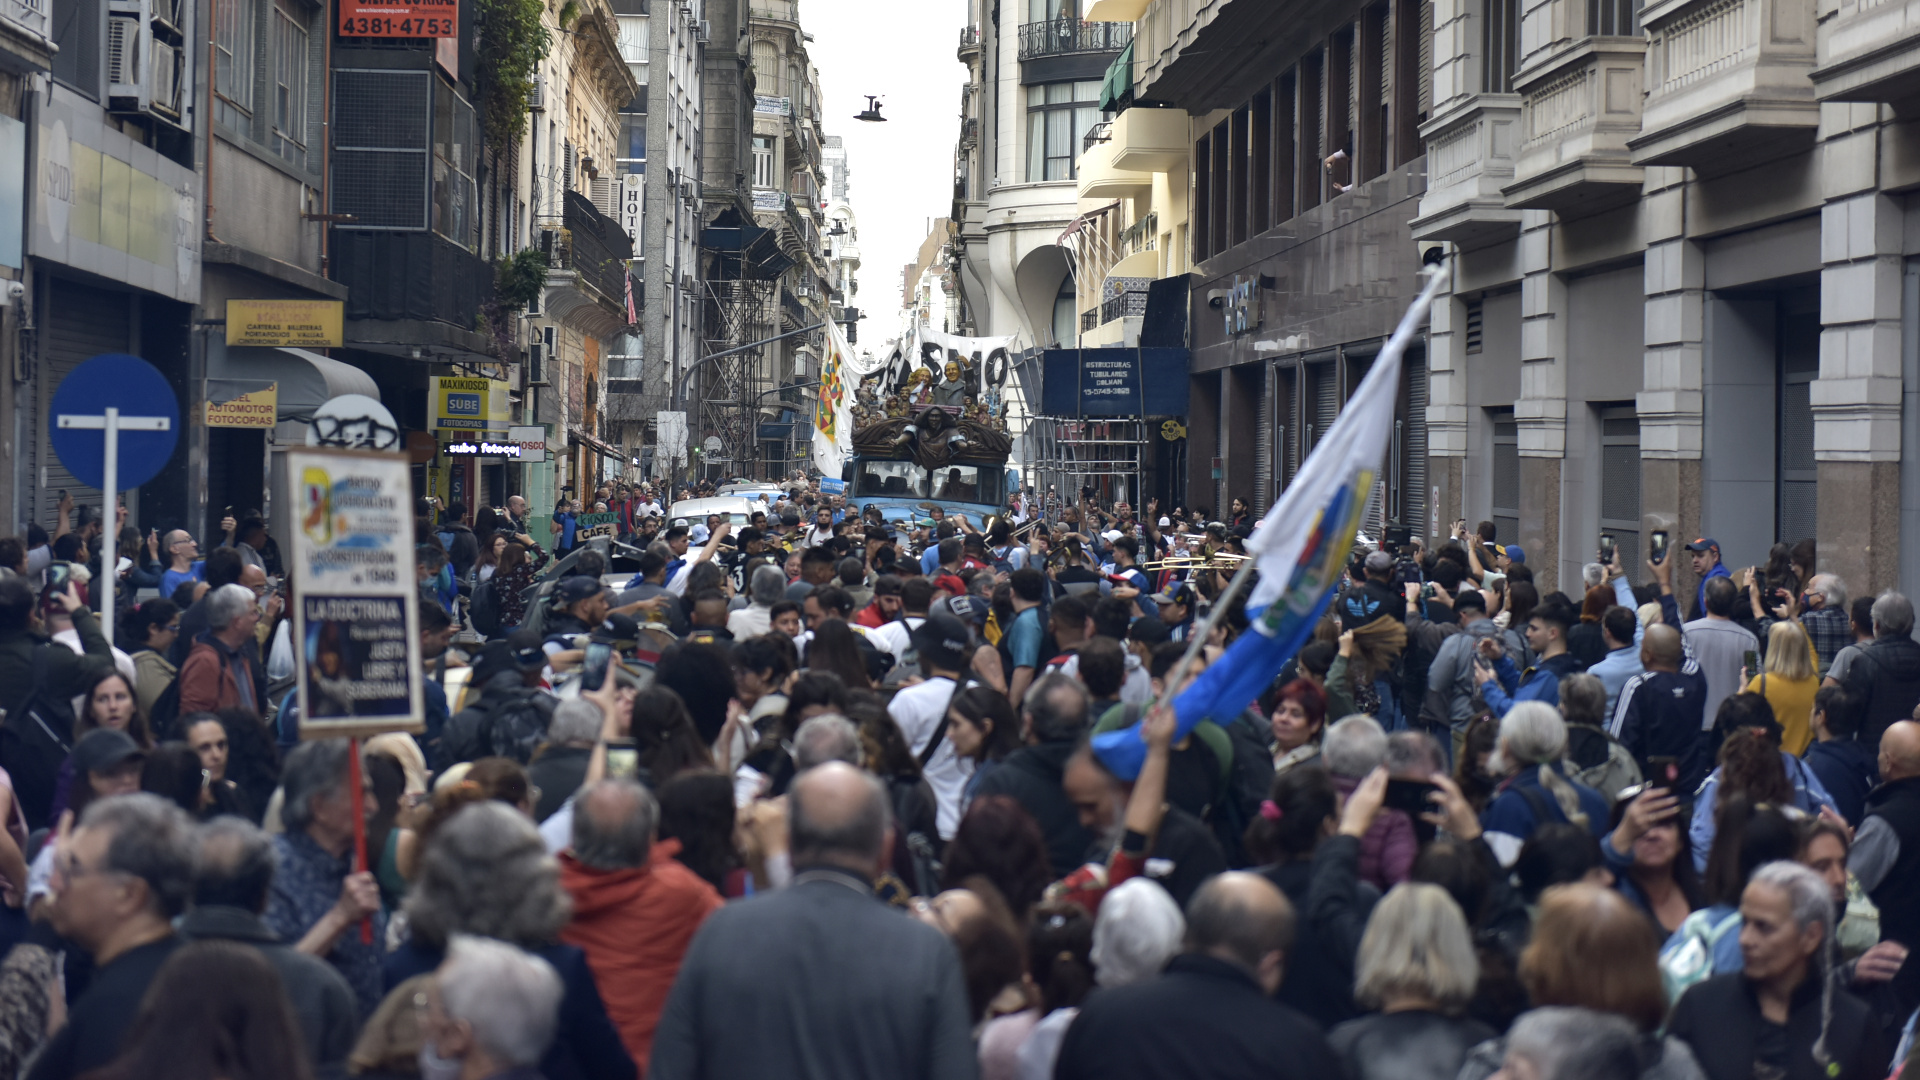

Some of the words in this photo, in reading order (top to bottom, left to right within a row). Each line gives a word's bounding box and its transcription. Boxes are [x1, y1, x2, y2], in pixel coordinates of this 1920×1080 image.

[627, 190, 638, 252] HOTE
[1090, 370, 1128, 378] TUBULARES
[440, 379, 489, 391] MAXIKIOSCO
[208, 404, 273, 414] AUTOMOTOR
[449, 399, 478, 410] SUBE
[208, 414, 273, 425] FOTOCOPIAS
[443, 419, 482, 428] FOTOCOPIAS
[449, 442, 478, 453] sube
[327, 599, 402, 621] DOCTRINA
